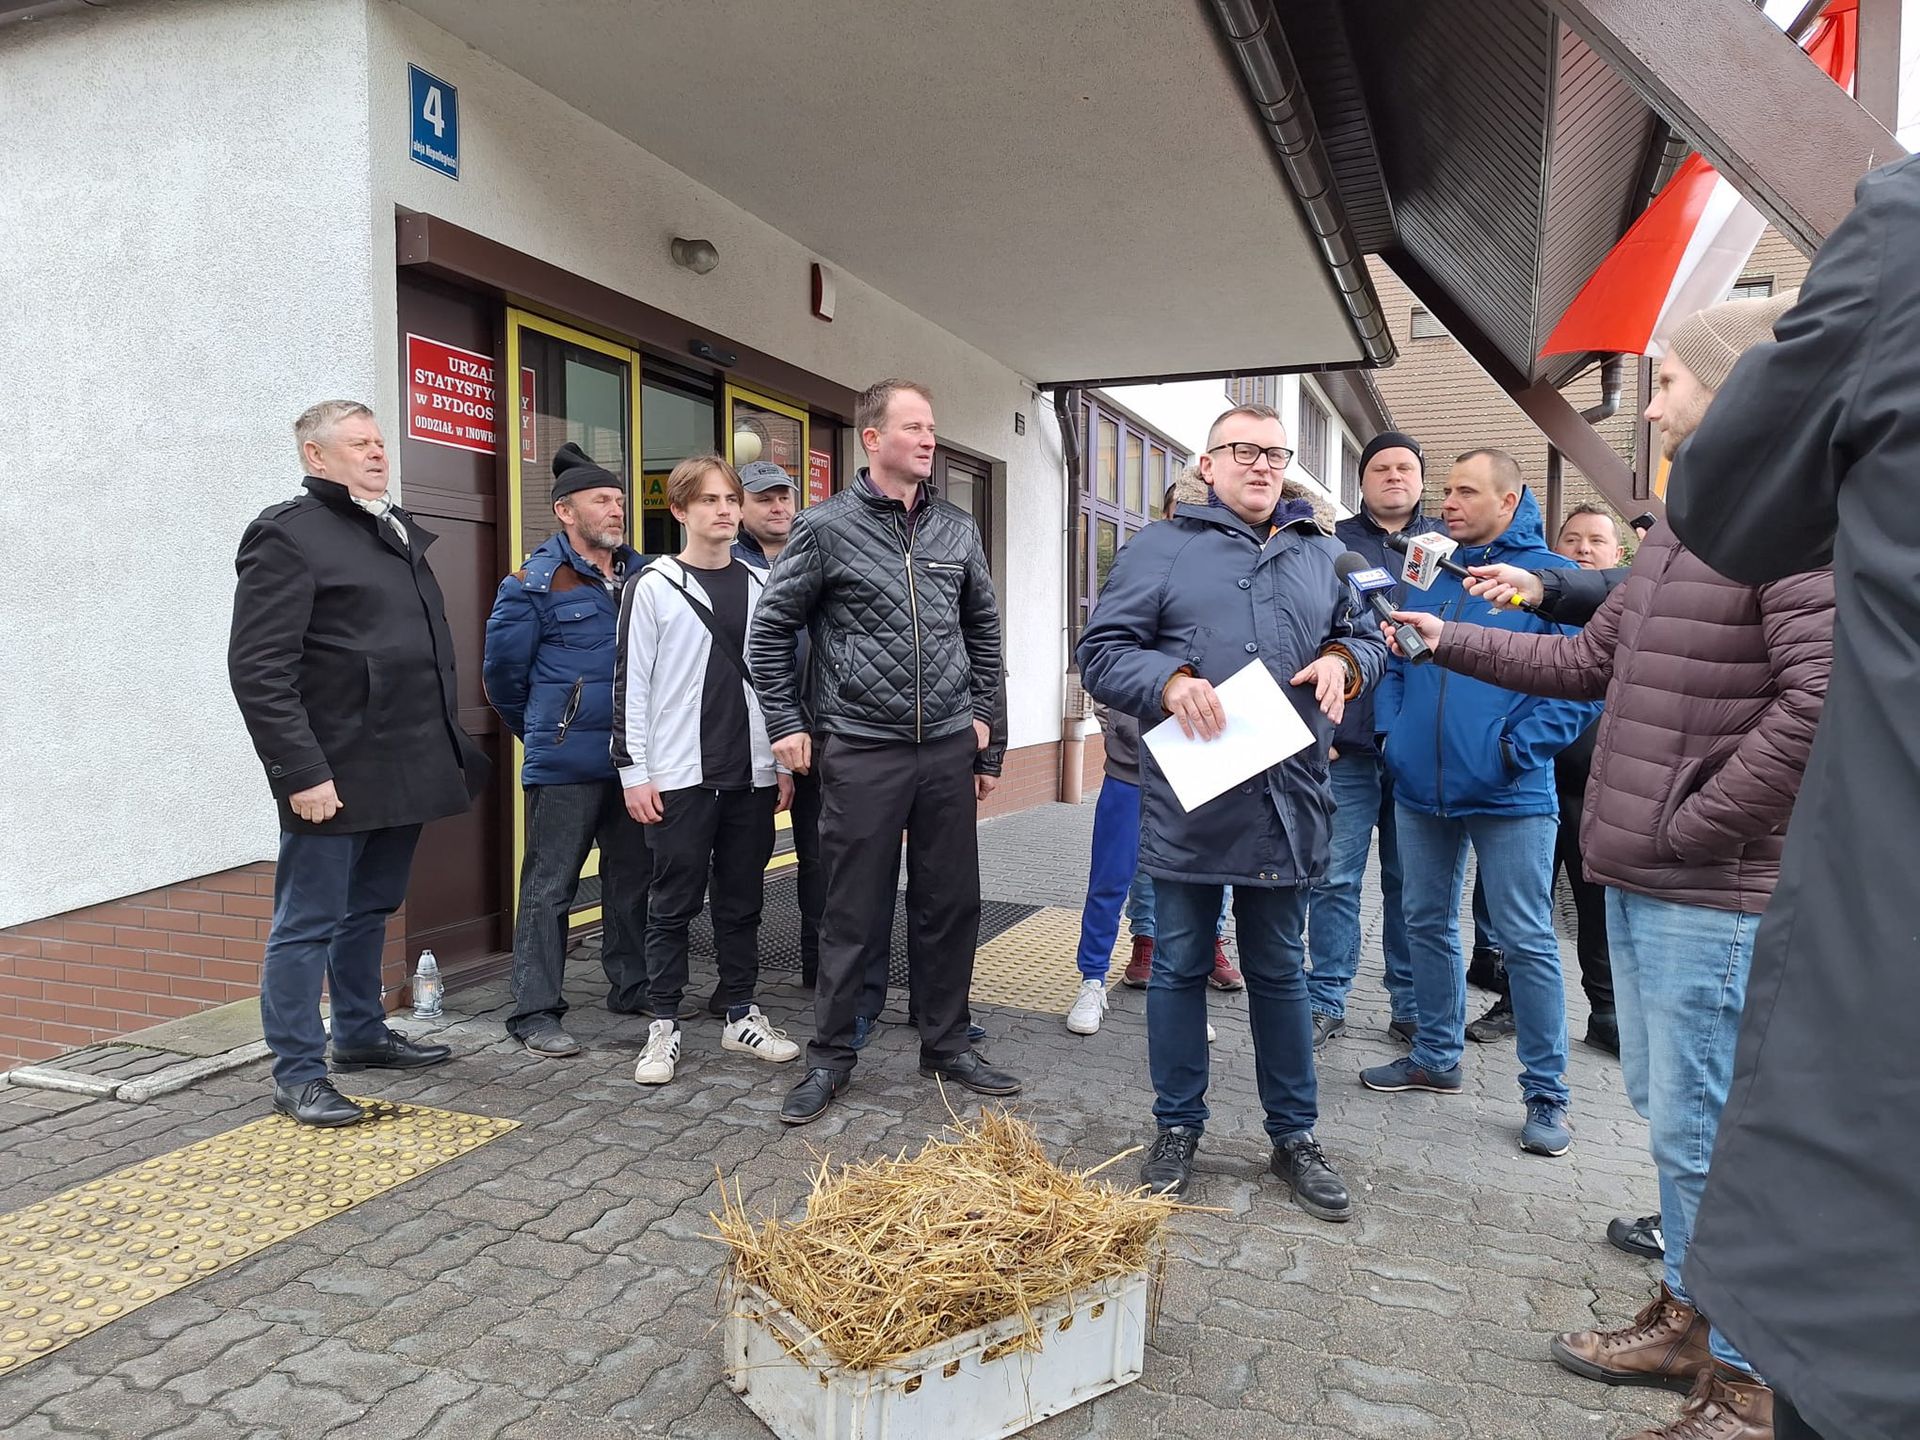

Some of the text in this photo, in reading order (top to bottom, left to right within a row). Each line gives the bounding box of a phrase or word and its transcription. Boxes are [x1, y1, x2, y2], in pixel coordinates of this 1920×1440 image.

[423, 85, 445, 138] 4
[415, 392, 428, 405] w
[415, 415, 454, 435] ODDZIAŁ
[455, 426, 464, 437] w
